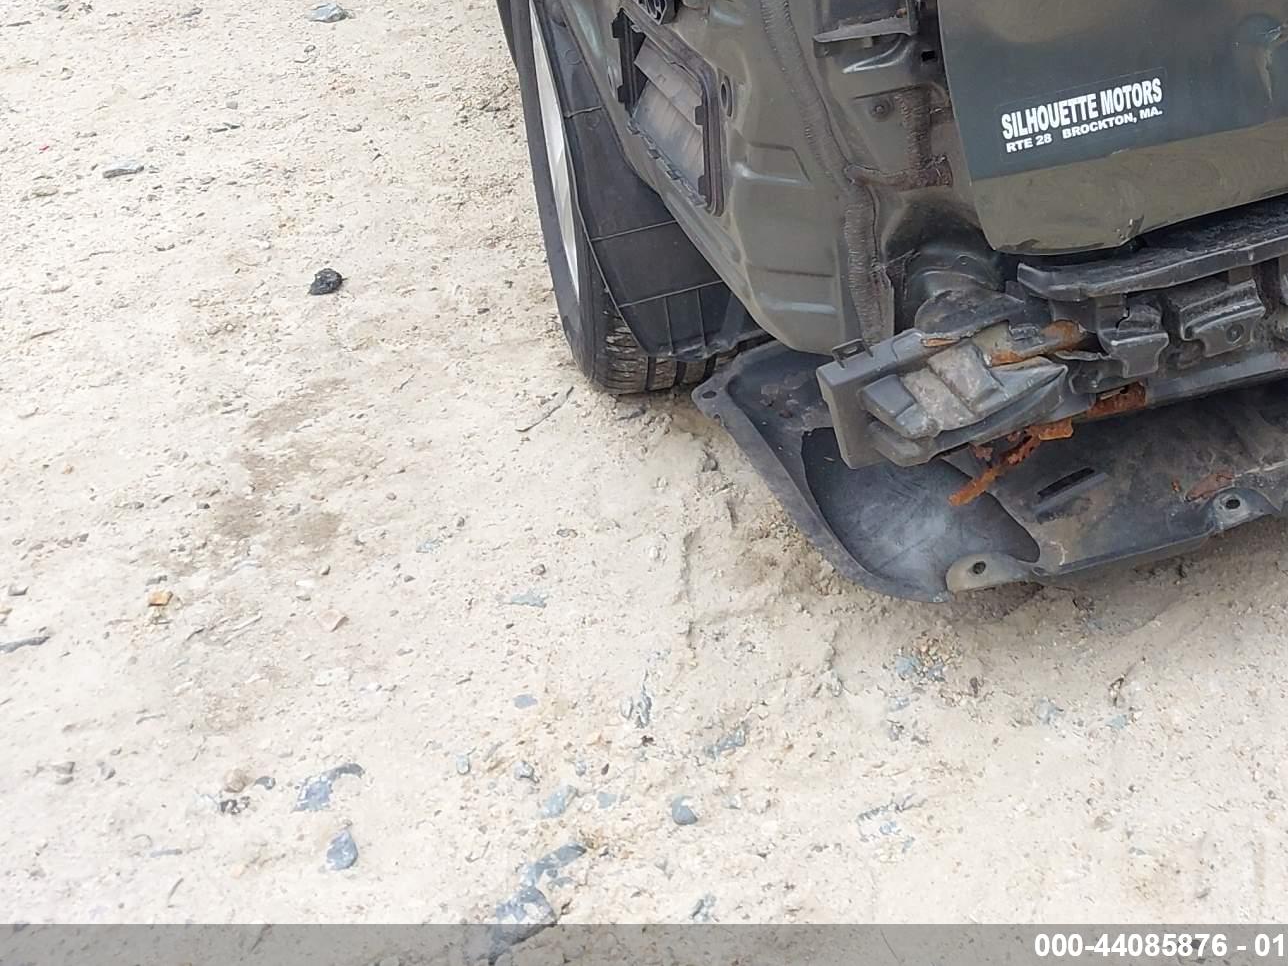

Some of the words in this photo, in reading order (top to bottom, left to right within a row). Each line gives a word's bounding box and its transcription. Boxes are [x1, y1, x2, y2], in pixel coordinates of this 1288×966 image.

[1001, 93, 1099, 140] SILHOUETTE
[1100, 77, 1163, 117] MOTORS
[1006, 137, 1033, 153] RTE
[1035, 133, 1053, 146] 28
[1062, 112, 1138, 139] BROCKTON,
[1139, 104, 1164, 120] MA.
